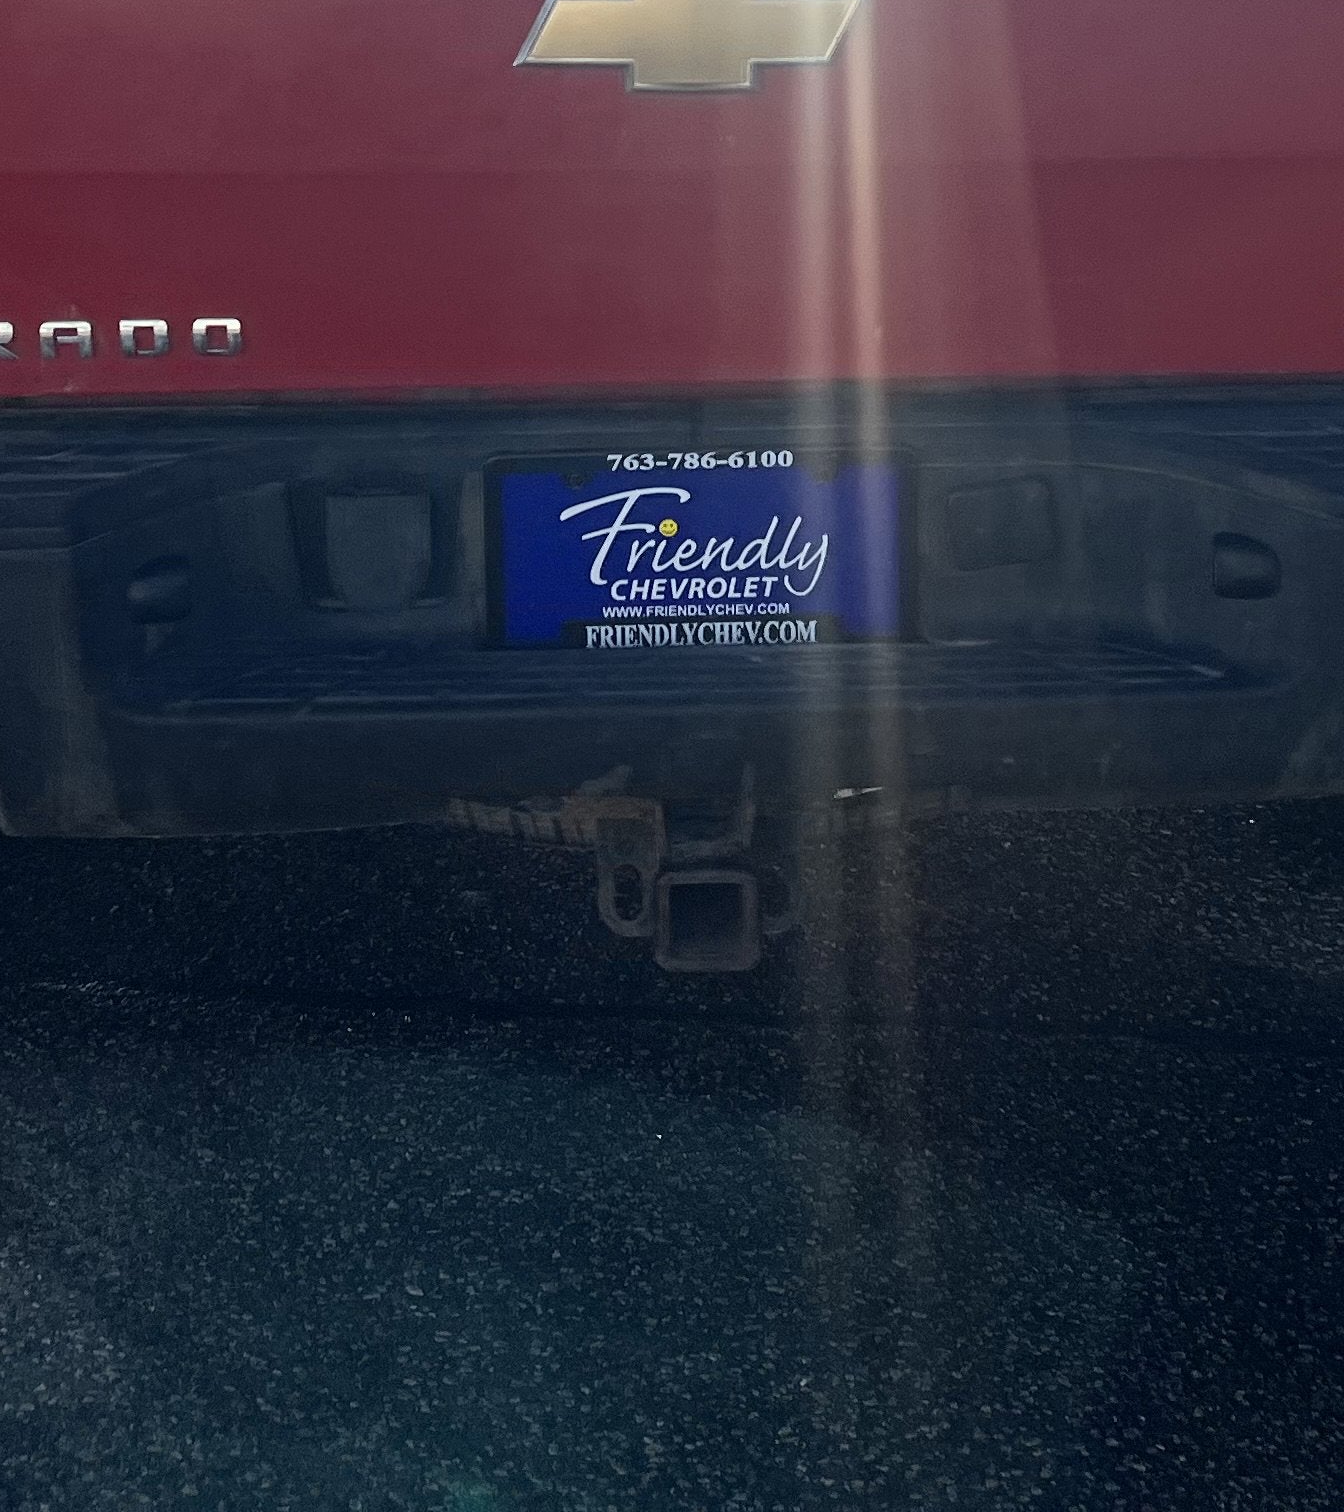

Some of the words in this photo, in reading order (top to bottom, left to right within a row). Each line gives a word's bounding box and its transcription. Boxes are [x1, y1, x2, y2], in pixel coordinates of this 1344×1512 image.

[607, 450, 794, 471] 763-786-6100
[560, 487, 829, 596] Friendly
[611, 576, 778, 601] CHEVROLET
[602, 603, 790, 618] WWW.FRIENDLYCHEV.COM
[585, 620, 817, 648] FRIENDLYCHEV.COM
